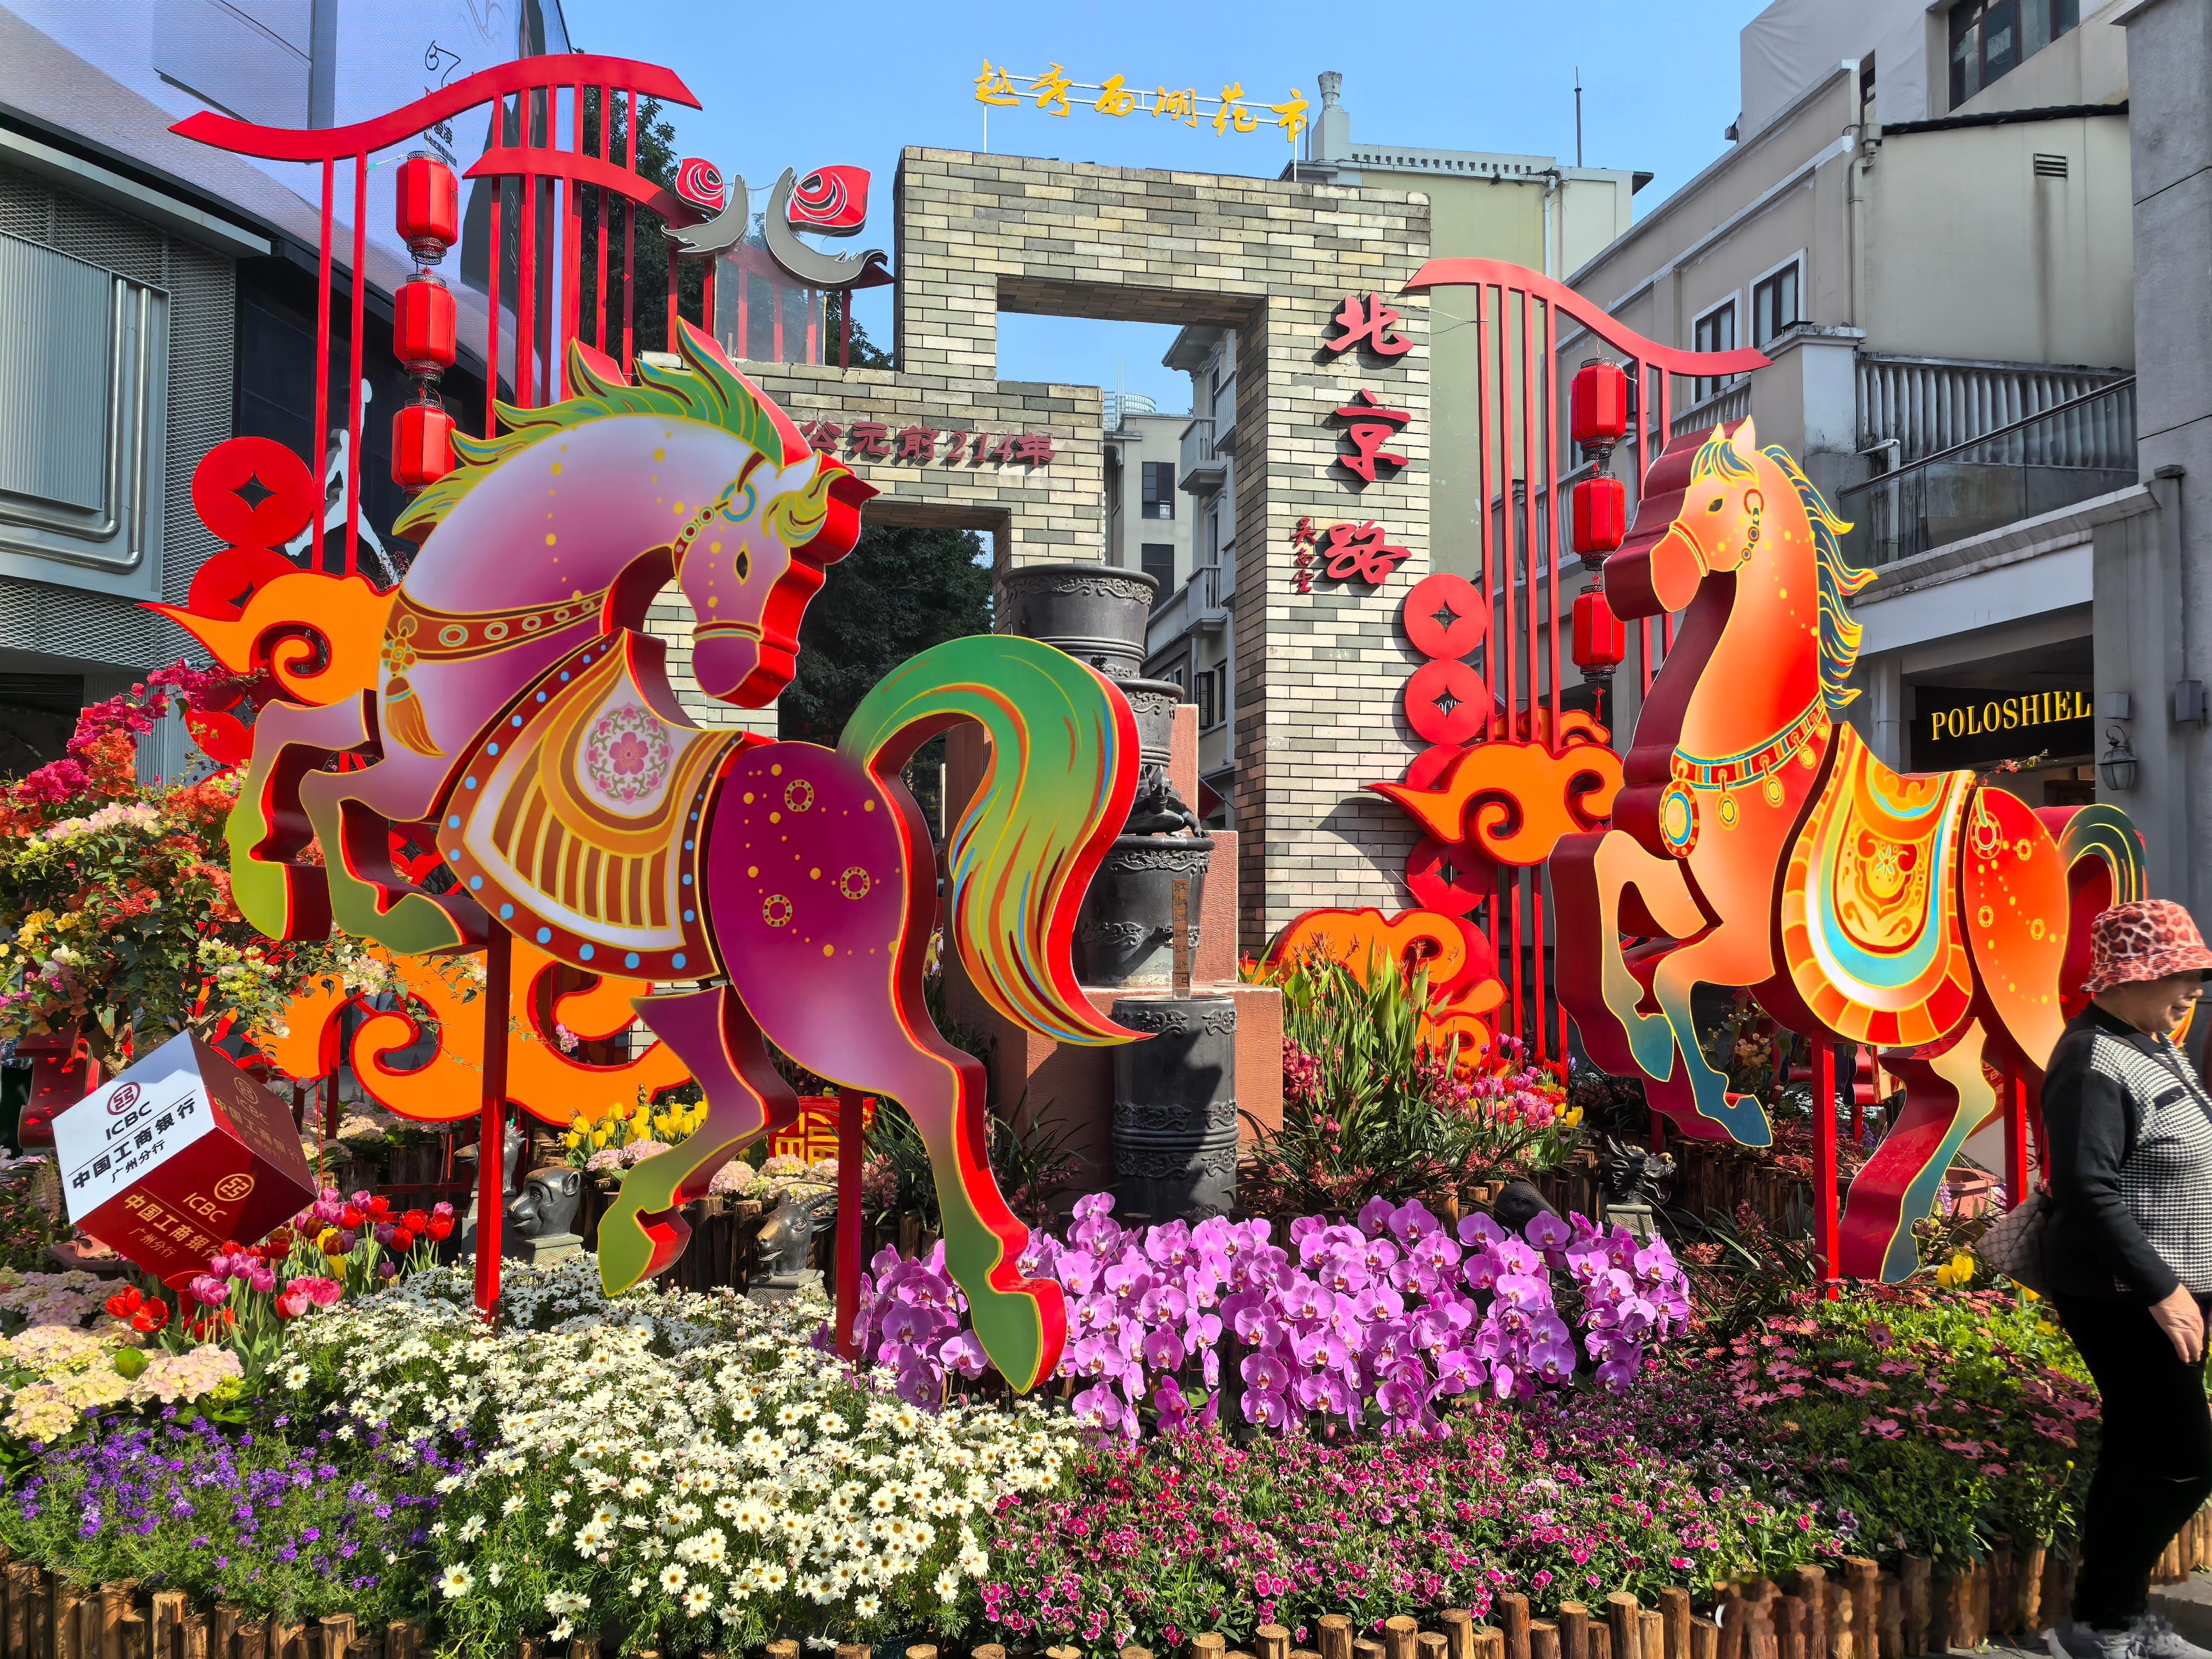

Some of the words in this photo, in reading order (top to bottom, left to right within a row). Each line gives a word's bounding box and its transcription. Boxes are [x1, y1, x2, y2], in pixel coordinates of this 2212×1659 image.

[974, 58, 1309, 142] 越秀西湖花市
[801, 420, 1056, 468] 公元前214年
[1325, 291, 1414, 584] 北京路
[1932, 691, 2095, 740] POLOSHIEL
[105, 1101, 153, 1141] ICBC
[236, 1095, 269, 1125] ICBC
[72, 1098, 195, 1189] 中国工商银行
[112, 1140, 166, 1183] 广州分行
[124, 1194, 222, 1261] 中国工商银行
[183, 1192, 227, 1222] ICBC
[128, 1228, 177, 1257] 广州分行
